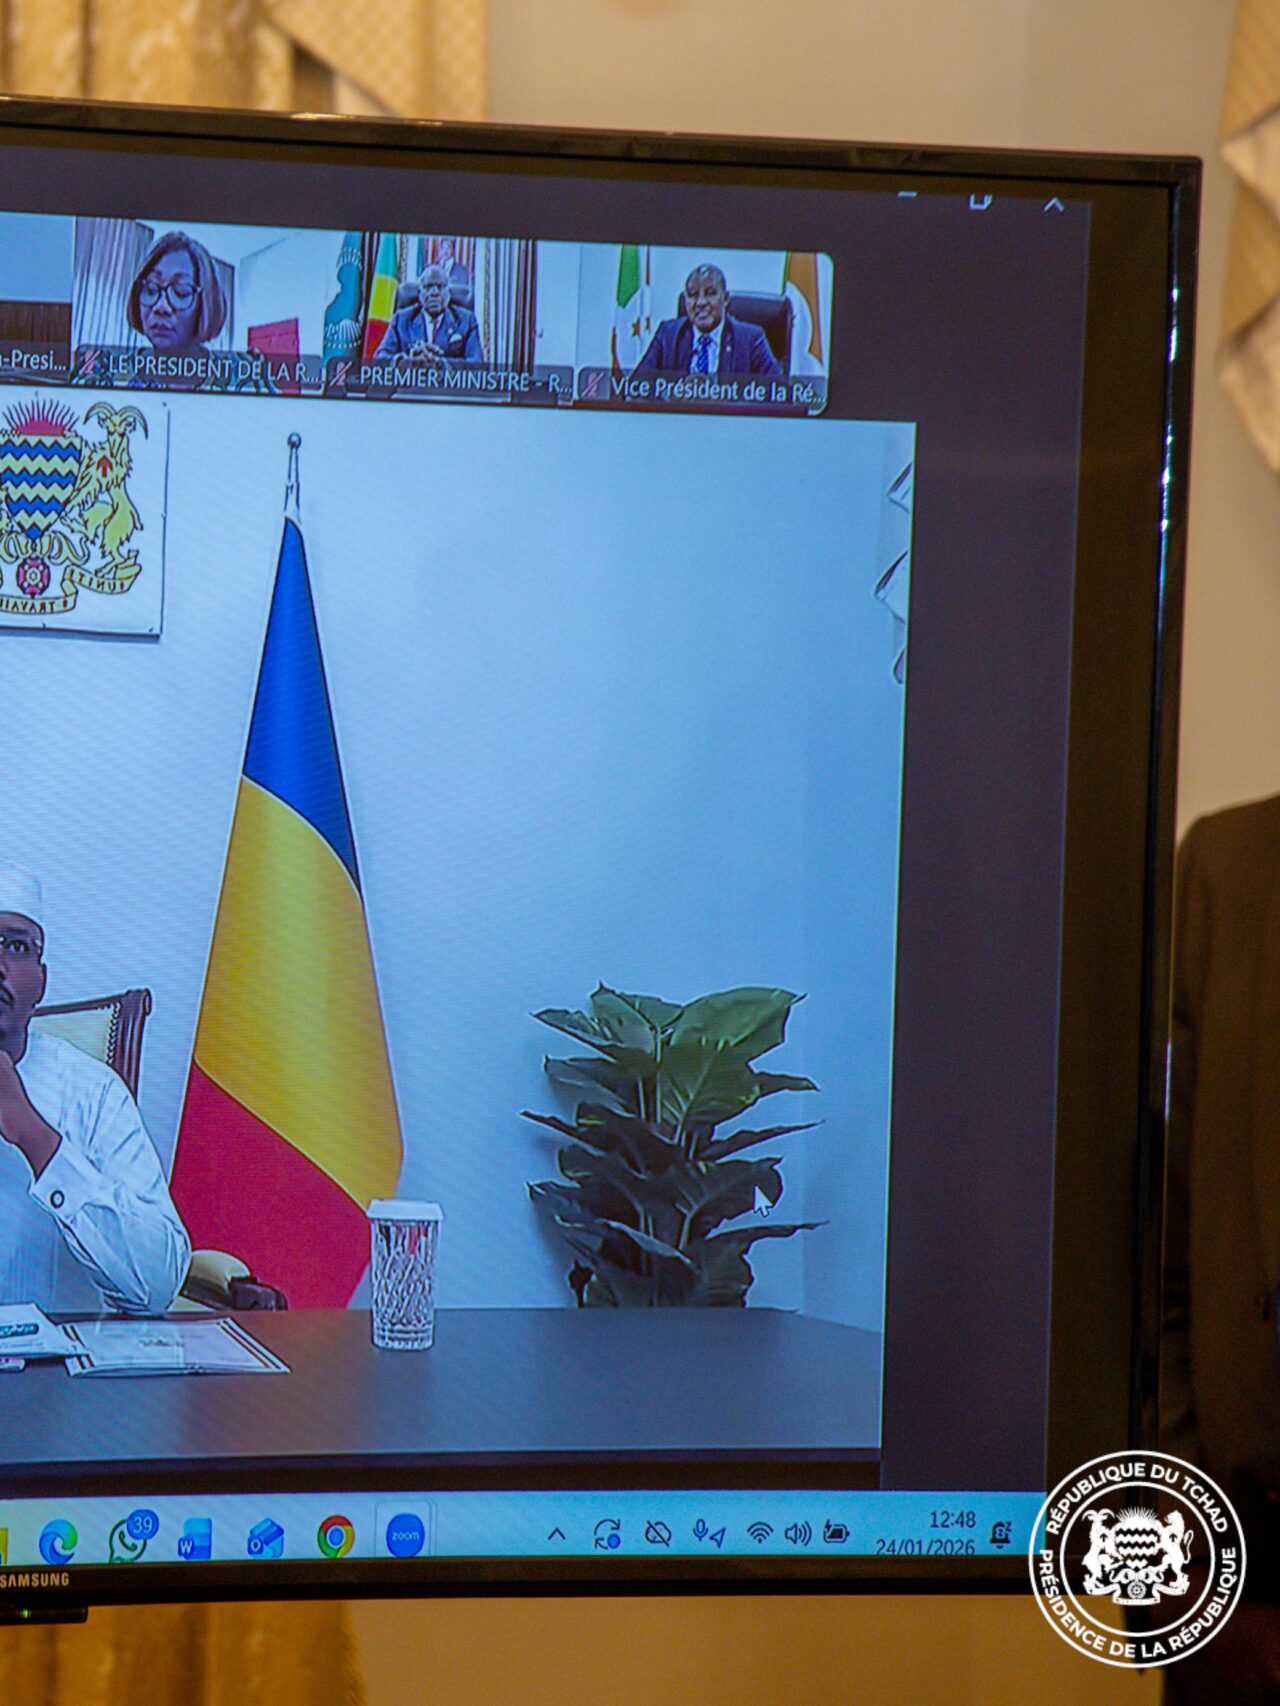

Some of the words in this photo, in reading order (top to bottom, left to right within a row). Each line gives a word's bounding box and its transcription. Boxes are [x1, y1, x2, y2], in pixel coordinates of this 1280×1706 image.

[109, 355, 128, 373] LE
[134, 356, 233, 378] PRESIDENT
[238, 361, 261, 380] DE
[267, 362, 290, 382] LA
[359, 366, 443, 387] PREMIER
[443, 369, 529, 392] MINISTRE
[611, 376, 650, 397] Vice
[655, 377, 738, 400] Président
[743, 379, 765, 401] de
[771, 381, 786, 402] la
[133, 1516, 153, 1533] 39
[930, 1510, 976, 1528] 12:48
[392, 1531, 420, 1541] zoom
[180, 1540, 193, 1554] W
[876, 1539, 975, 1555] 24/01/2026
[0, 1572, 69, 1588] SAMSUNG
